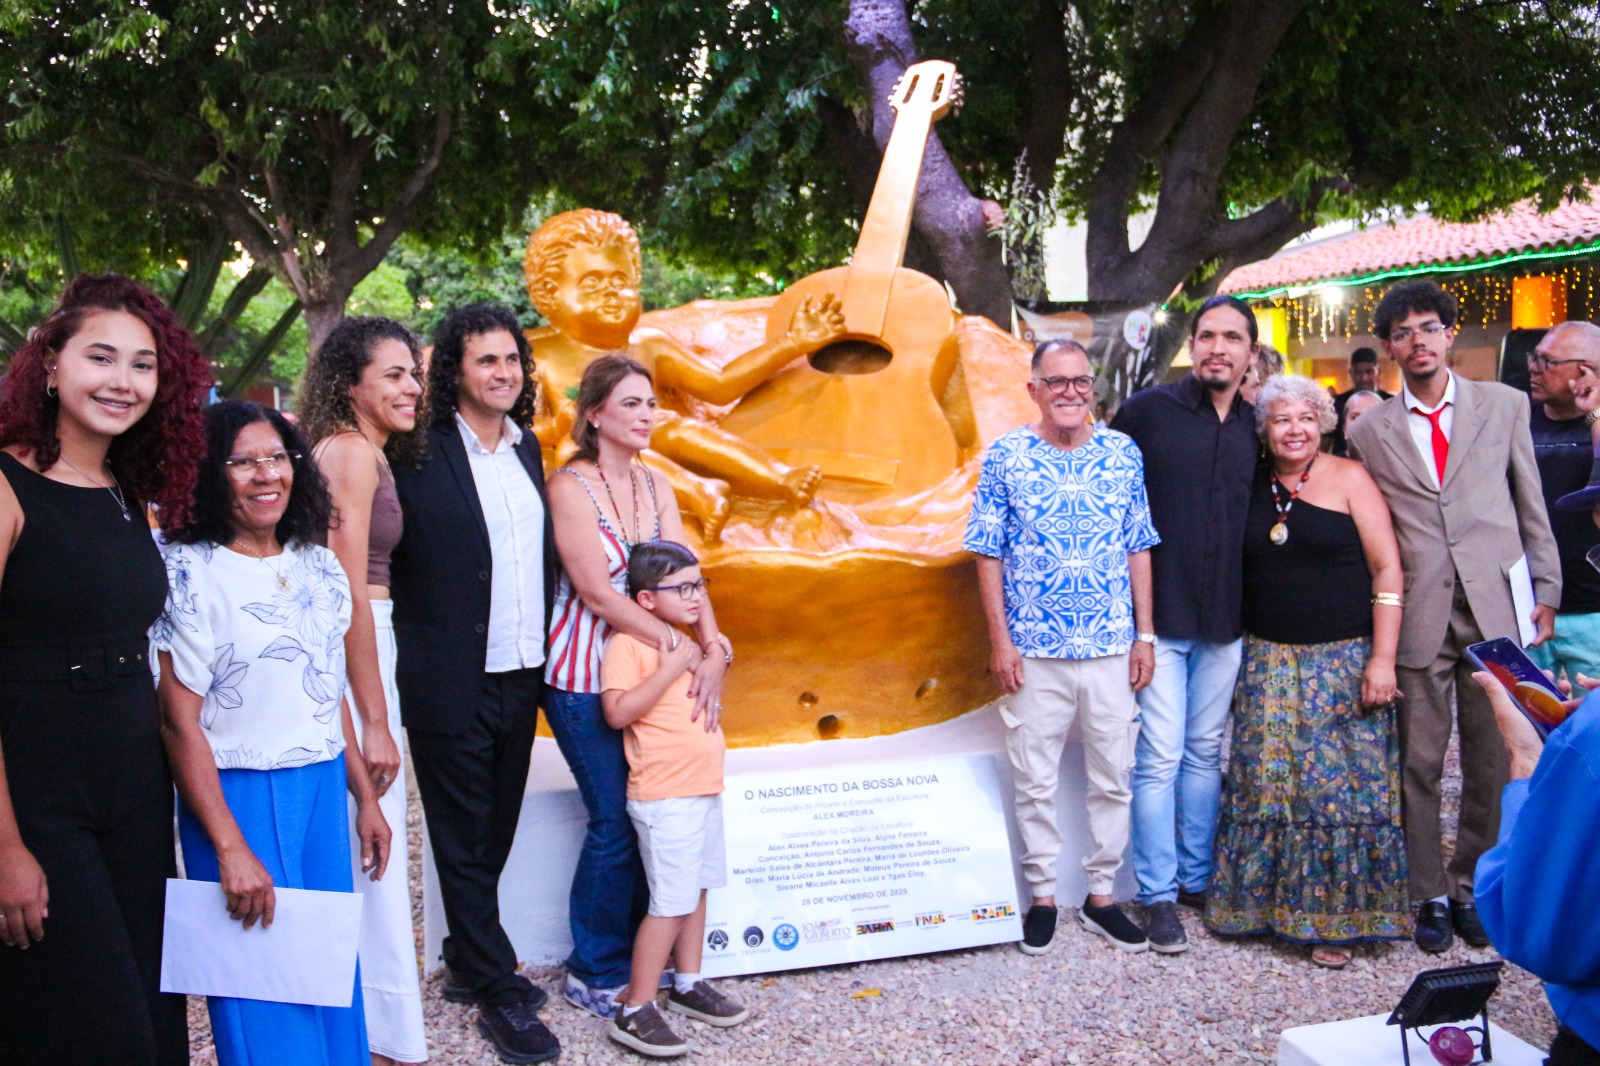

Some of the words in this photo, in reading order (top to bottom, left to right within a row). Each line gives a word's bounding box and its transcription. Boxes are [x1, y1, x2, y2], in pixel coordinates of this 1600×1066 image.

[744, 790, 754, 800] O
[758, 783, 838, 799] NASCIMENTO
[842, 782, 859, 792] DA
[863, 778, 903, 790] BOSSA
[906, 774, 939, 786] NOVA
[760, 804, 801, 814] Concepção
[815, 800, 840, 810] Projeto
[849, 796, 883, 806] Execução
[896, 793, 929, 802] Escultura
[813, 812, 834, 820] ALEX
[836, 809, 874, 818] MOREIRA
[781, 829, 826, 840] Colaboração
[840, 825, 867, 834] Criação
[880, 821, 914, 830] Escultura
[788, 842, 809, 850] Alves
[812, 839, 839, 848] Pereira
[875, 834, 896, 842] Alyne
[898, 831, 927, 839] Ferreira
[804, 850, 834, 858] Antonio
[837, 847, 861, 855] Carlos
[863, 843, 903, 852] Fernandes
[733, 866, 766, 875] Marleide
[769, 864, 791, 872] Sales
[793, 862, 802, 870] de
[805, 858, 842, 868] Alcântara
[909, 849, 940, 858] Lourdes
[942, 846, 970, 854] Oliveira
[792, 872, 813, 880] Lúcia
[864, 864, 891, 872] Mateus
[894, 861, 920, 869] Pereira
[840, 877, 860, 885] Alves
[863, 875, 879, 883] Leal
[801, 898, 810, 906] 28
[813, 896, 824, 905] DE
[827, 892, 874, 903] NOVEMBRO
[877, 890, 887, 898] DE
[890, 888, 908, 896] 2025
[805, 927, 851, 940] GILBERTO
